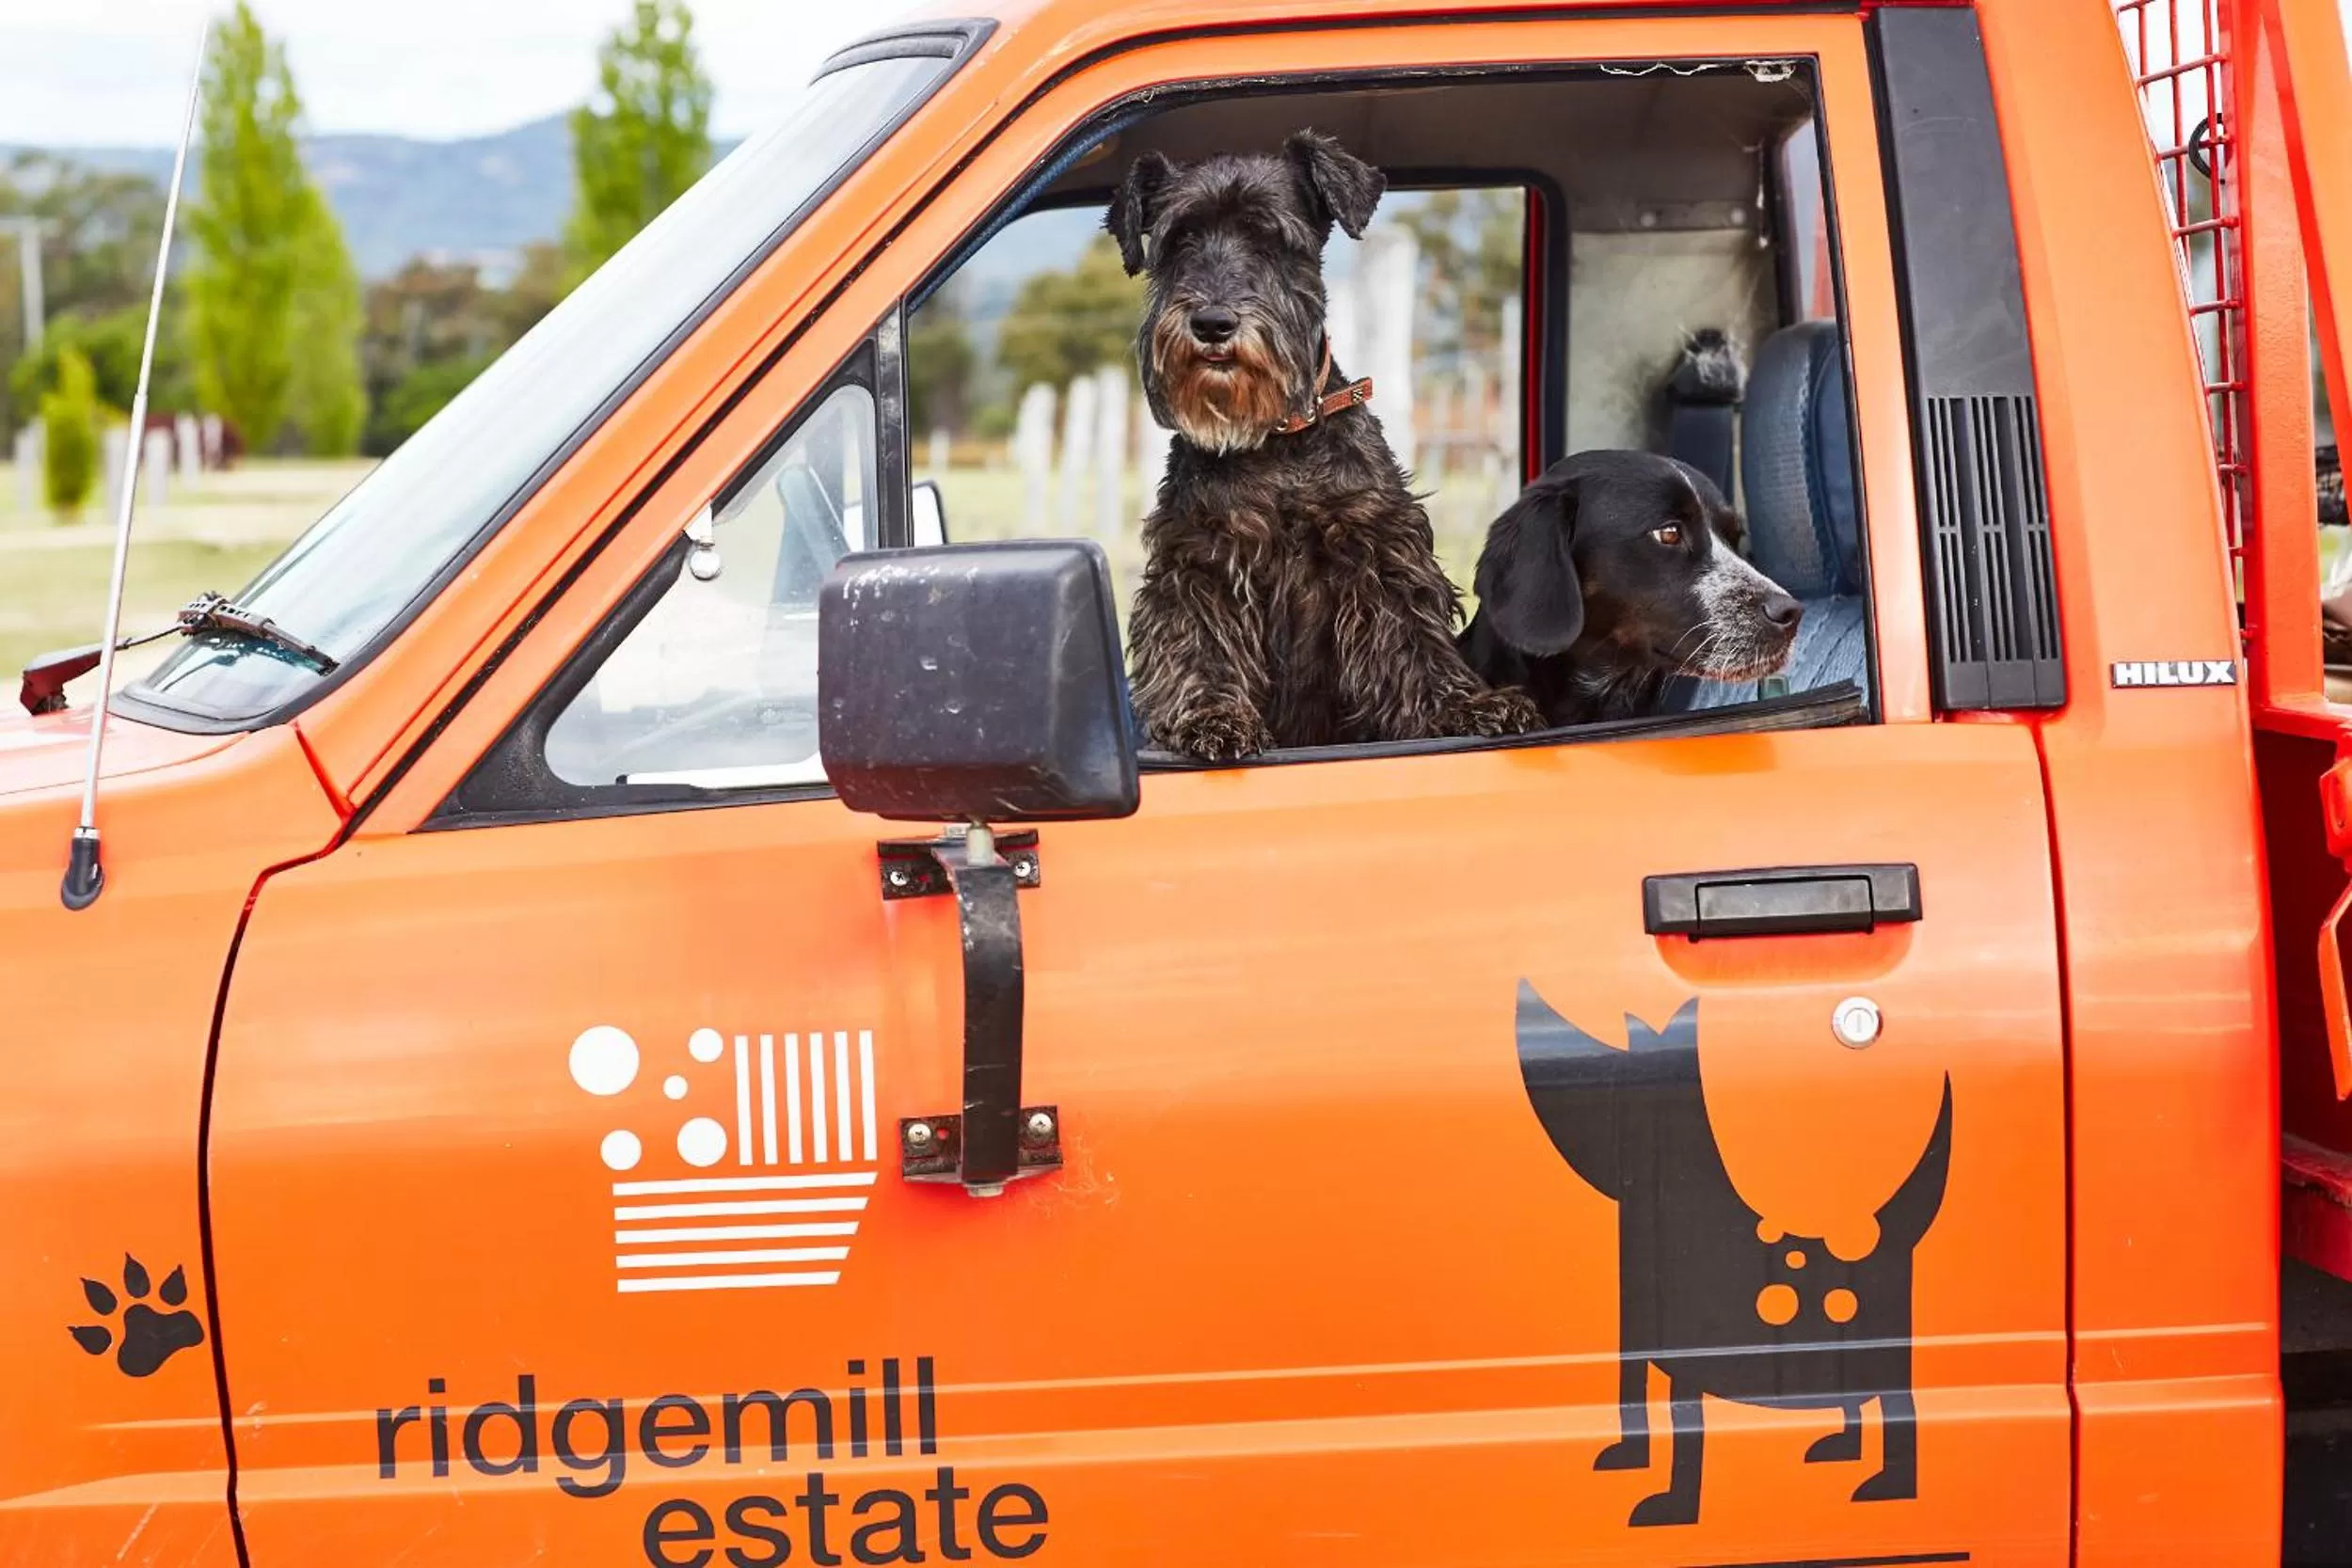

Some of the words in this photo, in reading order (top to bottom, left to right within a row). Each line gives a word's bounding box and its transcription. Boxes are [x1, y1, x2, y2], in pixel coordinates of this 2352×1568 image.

[2115, 660, 2235, 686] HILUX
[375, 1356, 938, 1497] ridgemill
[643, 1466, 1049, 1568] estate
